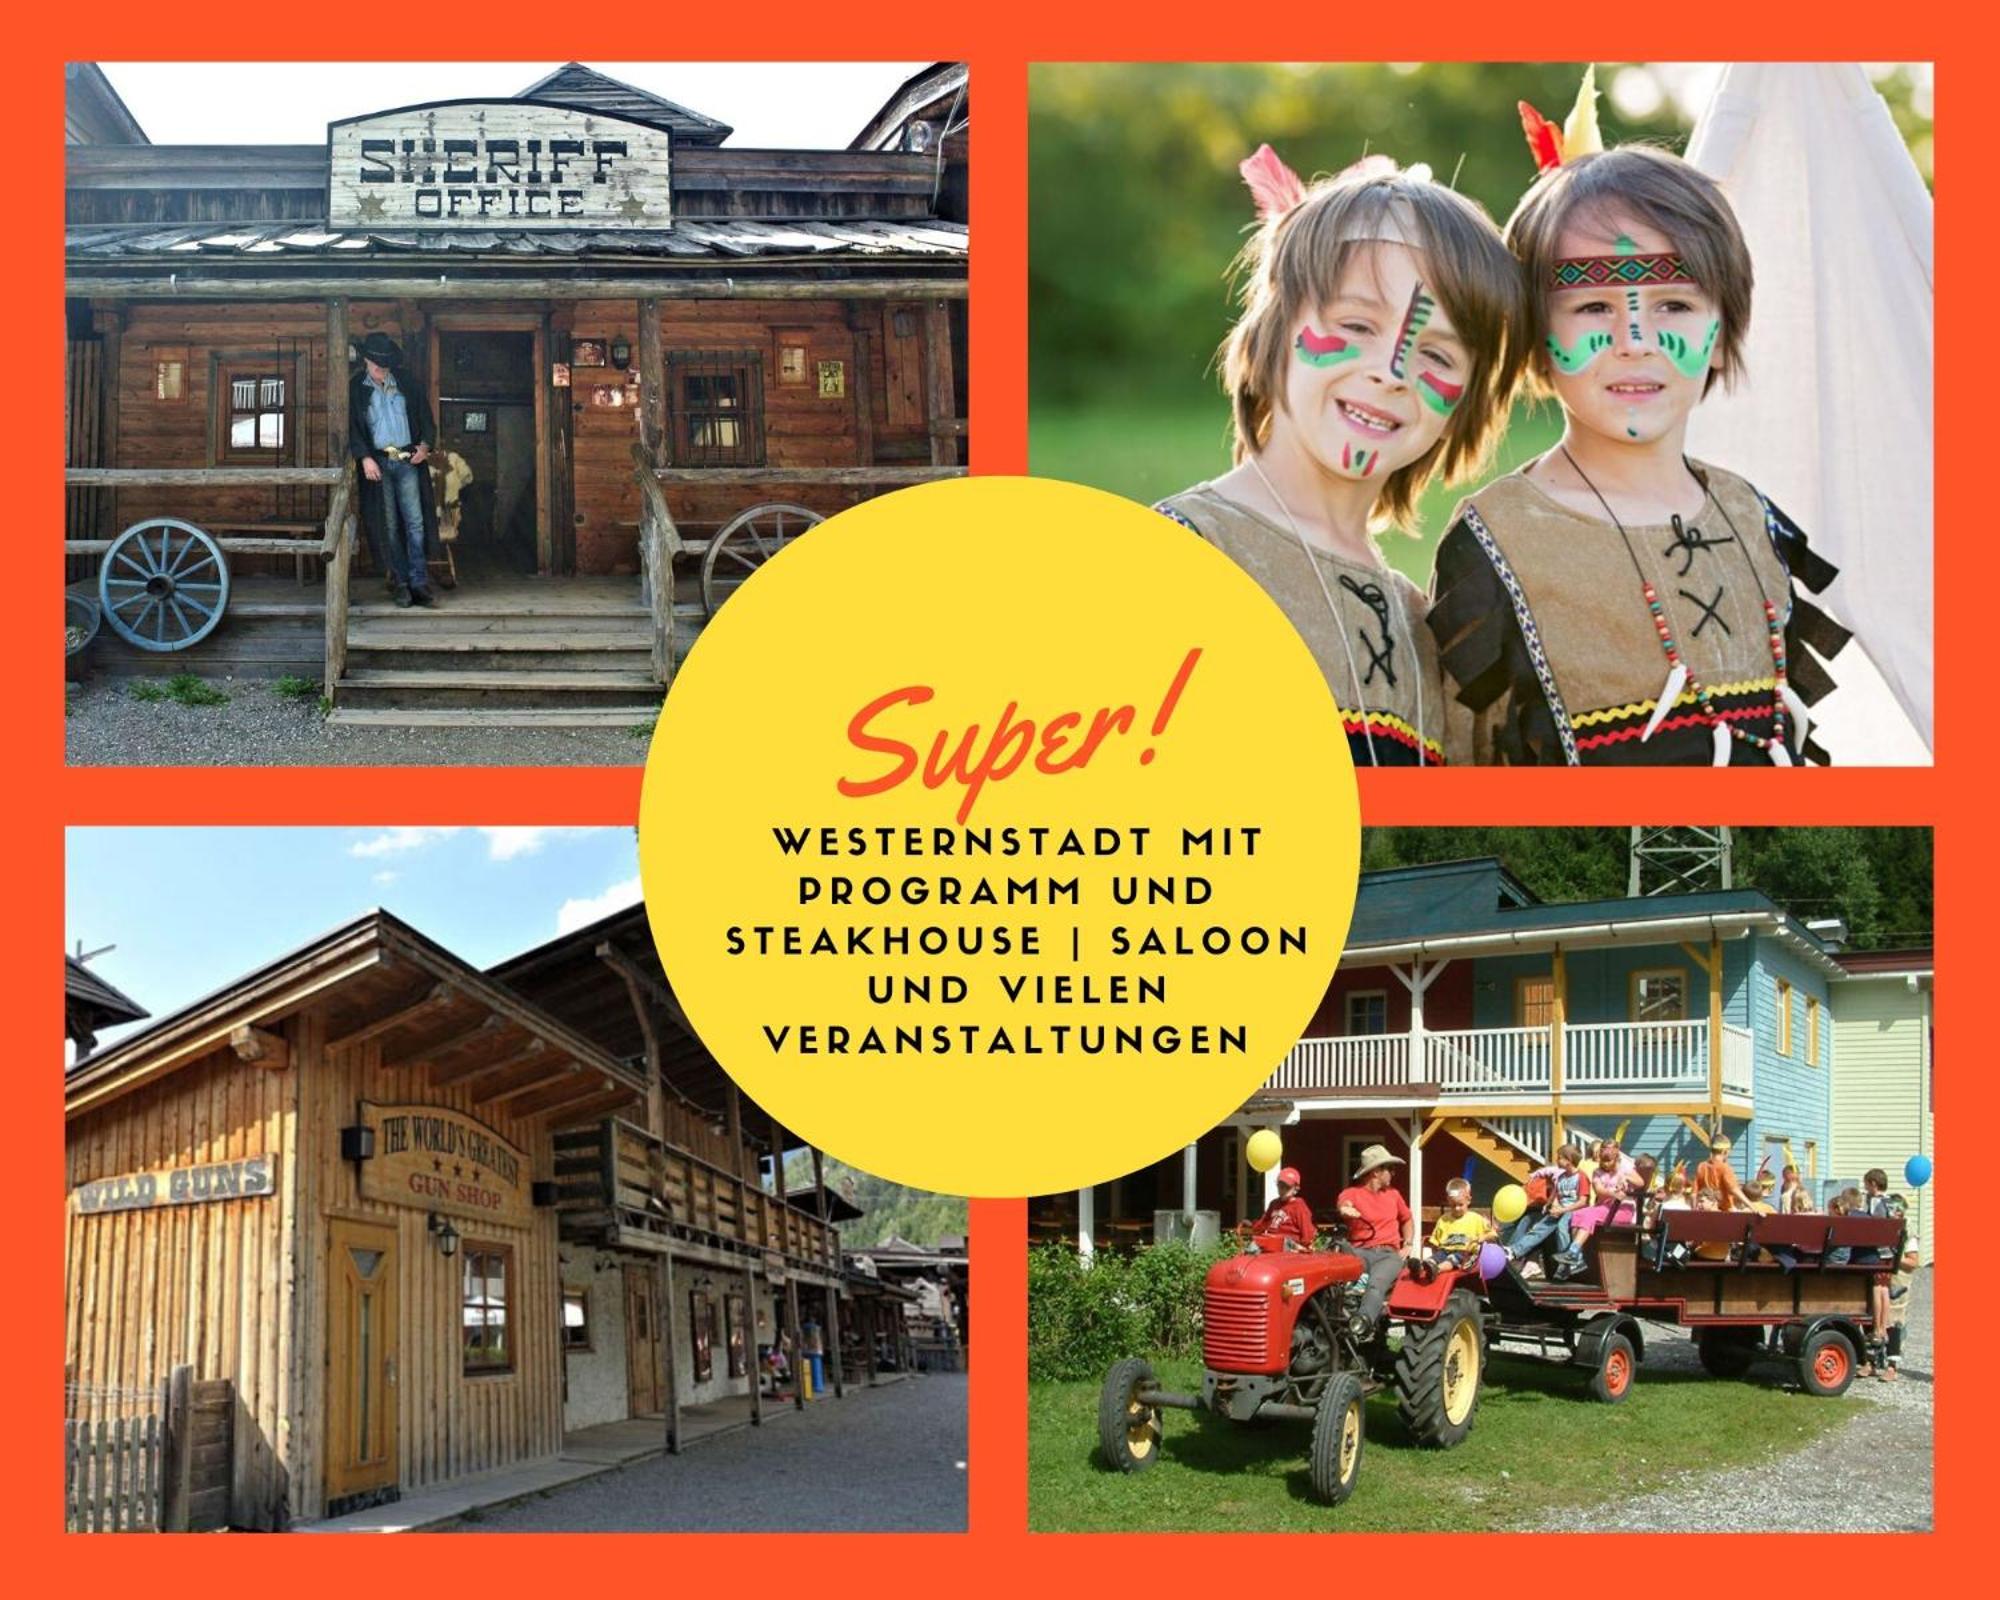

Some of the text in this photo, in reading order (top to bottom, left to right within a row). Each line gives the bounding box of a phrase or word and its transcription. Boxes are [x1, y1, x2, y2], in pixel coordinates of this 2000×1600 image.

[360, 139, 628, 184] SHERIFF
[415, 188, 584, 218] OFFICE
[383, 1116, 519, 1189] THE WORLD'S GREATEST
[78, 1157, 268, 1212] WILD GUNS
[408, 1171, 502, 1210] GUN SHOP
